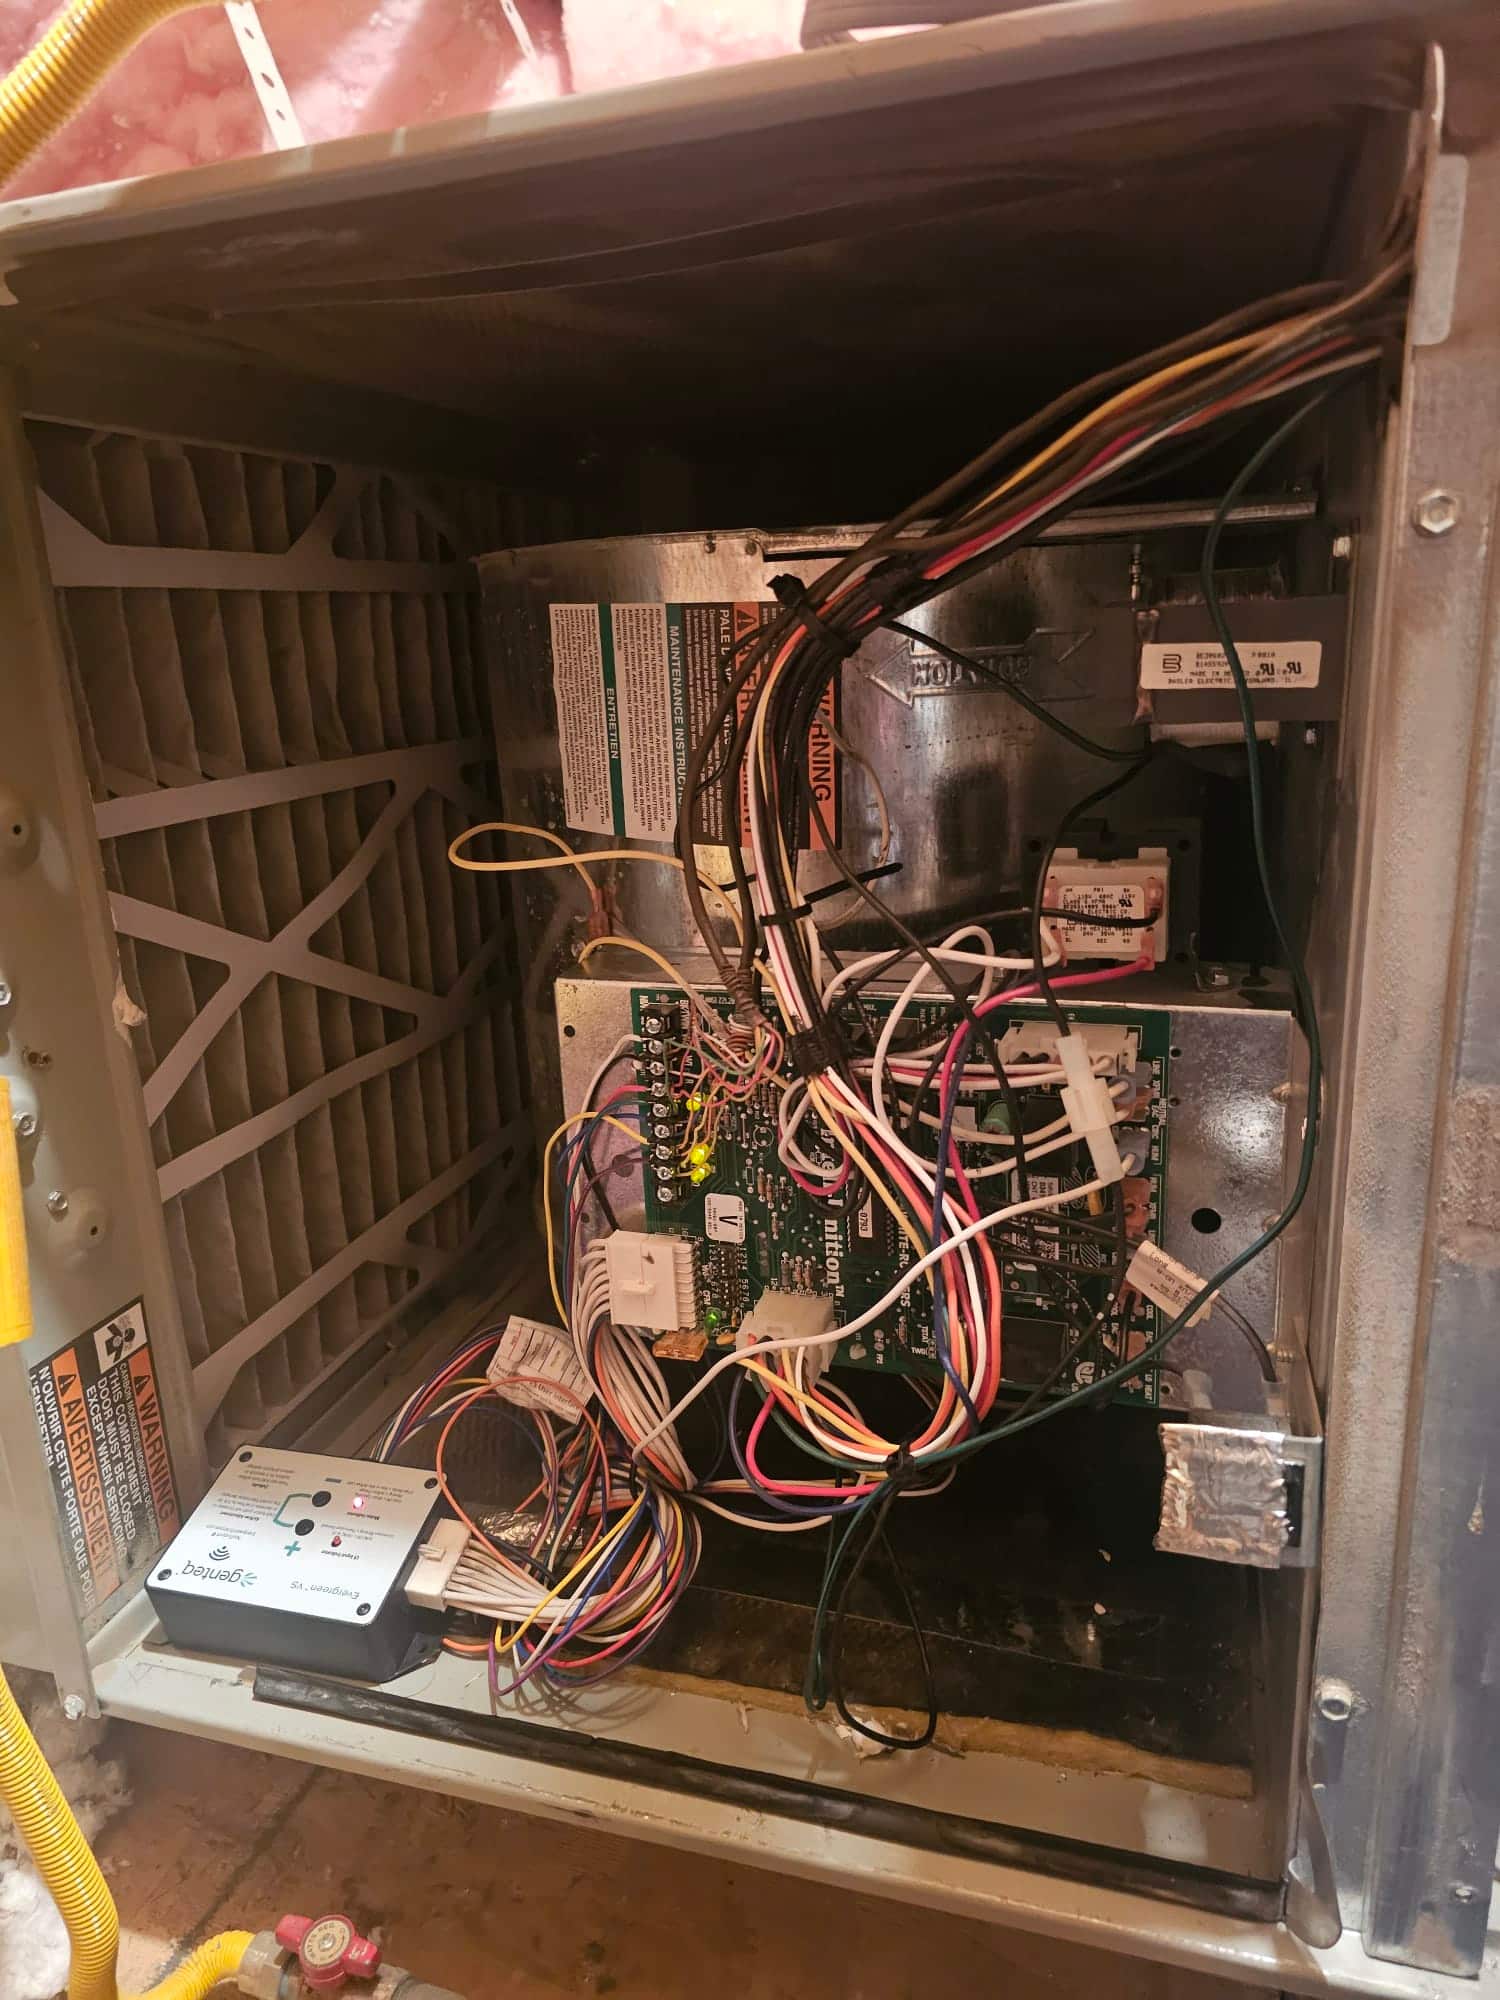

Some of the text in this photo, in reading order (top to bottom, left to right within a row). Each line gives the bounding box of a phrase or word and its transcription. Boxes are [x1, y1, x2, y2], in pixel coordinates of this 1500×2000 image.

[720, 609, 731, 643] PALE
[606, 687, 618, 759] ENTRETIEN
[669, 625, 687, 807] MAINTENANCE INSTRUC
[719, 1215, 738, 1226] V
[1145, 1304, 1153, 1320] COOL
[86, 1385, 105, 1441] EXCEPT
[97, 1441, 113, 1486] WHEN
[109, 1367, 142, 1506] THIS COMPARTMENT
[1144, 1384, 1152, 1400] HEAT
[39, 1366, 62, 1438] N'OUVRIR
[53, 1440, 71, 1489] CETTE
[63, 1488, 82, 1539] PORTE
[73, 1538, 89, 1571] QUE
[63, 1398, 114, 1577] AVERTISSEMENT
[97, 1377, 136, 1540] DOOR MUST BE CLOSED
[140, 1392, 175, 1520] WARNING
[182, 1560, 244, 1583] genteq
